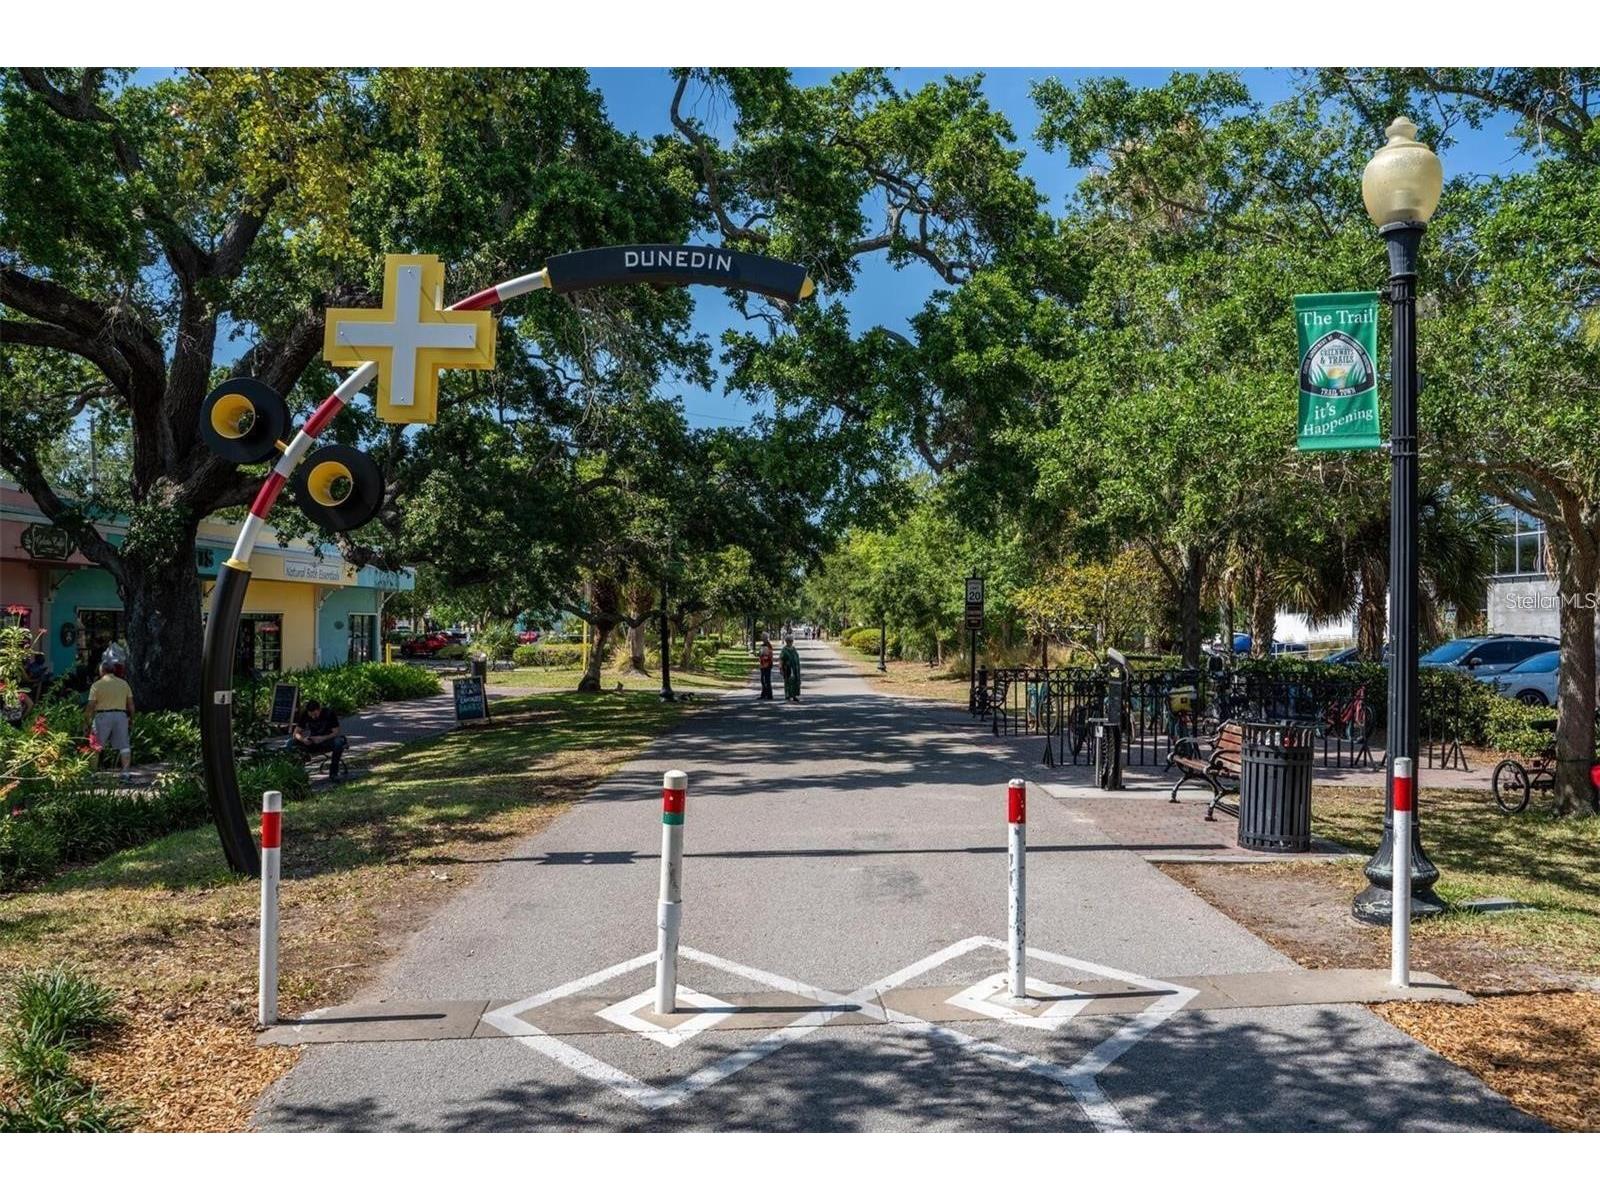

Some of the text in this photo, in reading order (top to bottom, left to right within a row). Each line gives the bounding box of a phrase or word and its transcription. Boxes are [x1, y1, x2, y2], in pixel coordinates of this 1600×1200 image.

[624, 251, 731, 272] DUNEDIN
[1299, 308, 1374, 326] The Trail
[1328, 355, 1354, 364] TRAILS
[1314, 402, 1336, 420] it's
[1303, 409, 1374, 436] Happening
[969, 591, 981, 600] 20
